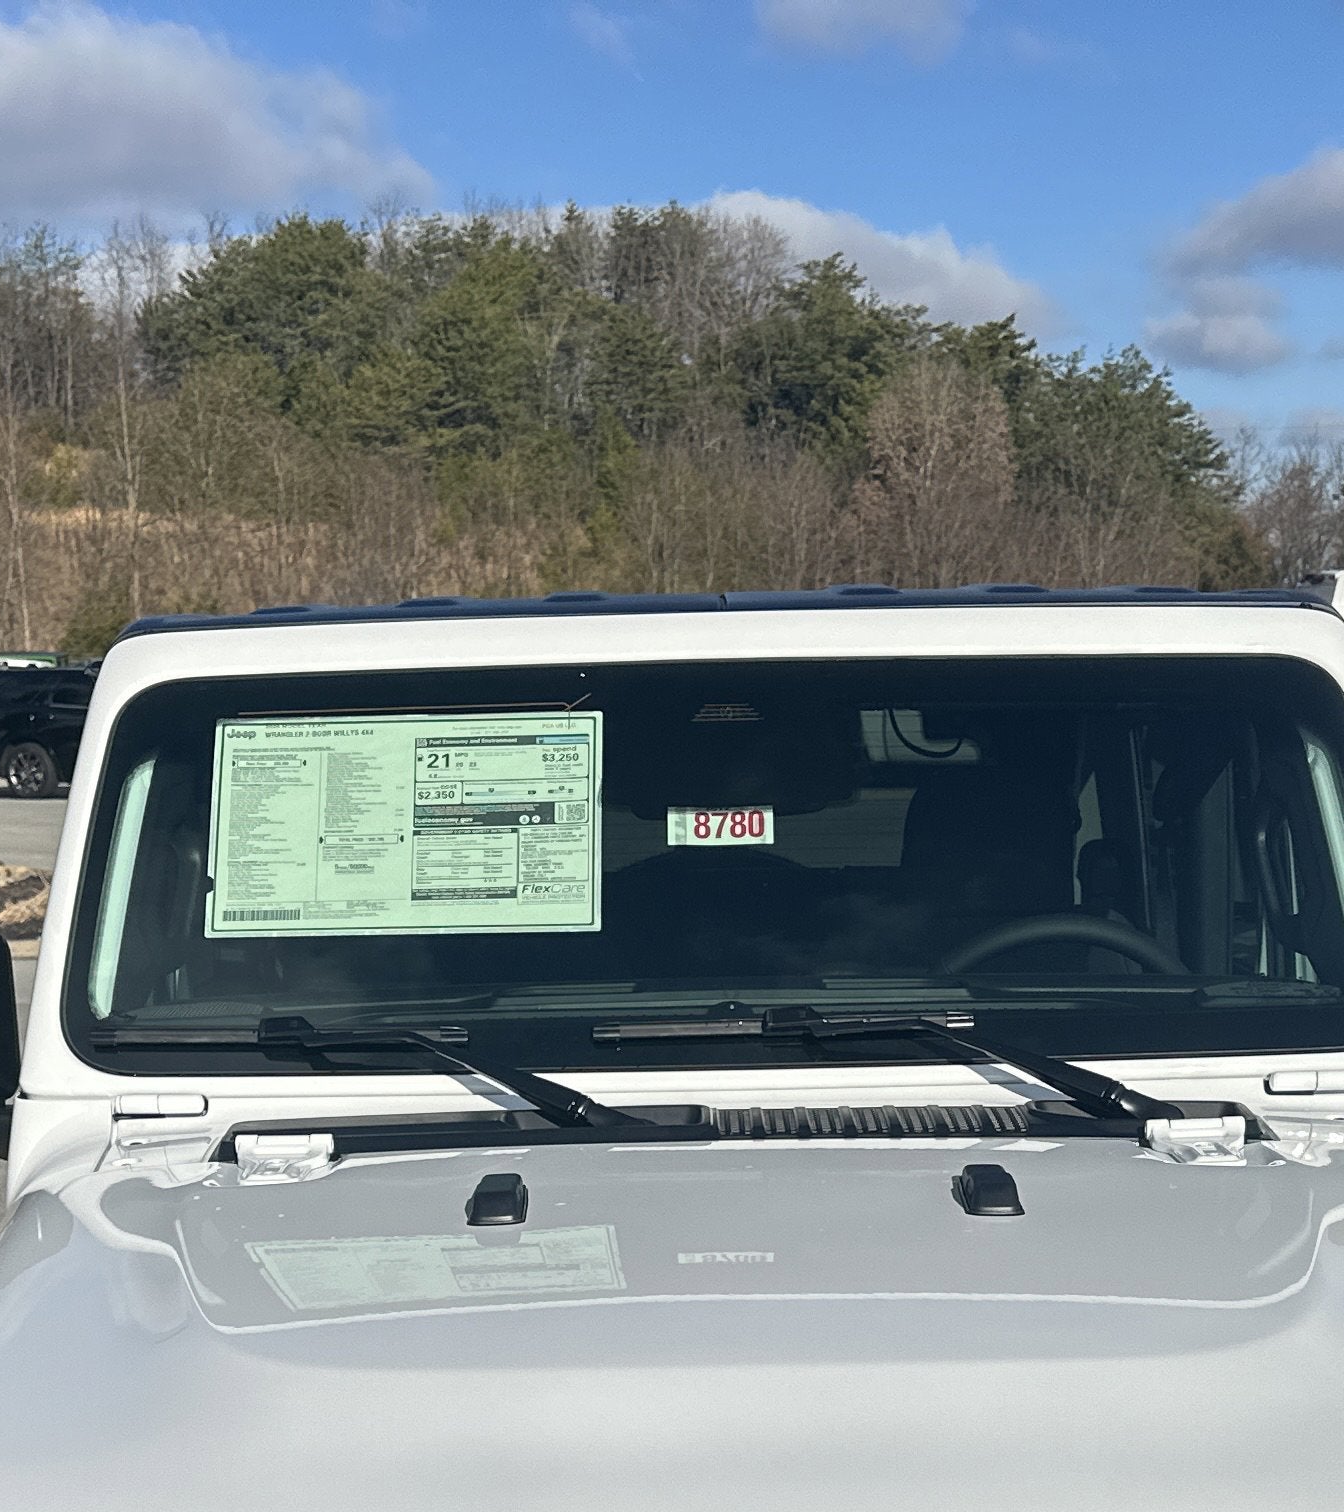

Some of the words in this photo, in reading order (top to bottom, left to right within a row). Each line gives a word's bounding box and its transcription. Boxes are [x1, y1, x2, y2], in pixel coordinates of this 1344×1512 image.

[227, 728, 256, 740] Jeep
[427, 753, 450, 768] 21
[542, 753, 579, 762] $3,250
[417, 790, 455, 800] $2,350
[694, 809, 764, 839] 8780
[522, 884, 585, 894] FlexCare
